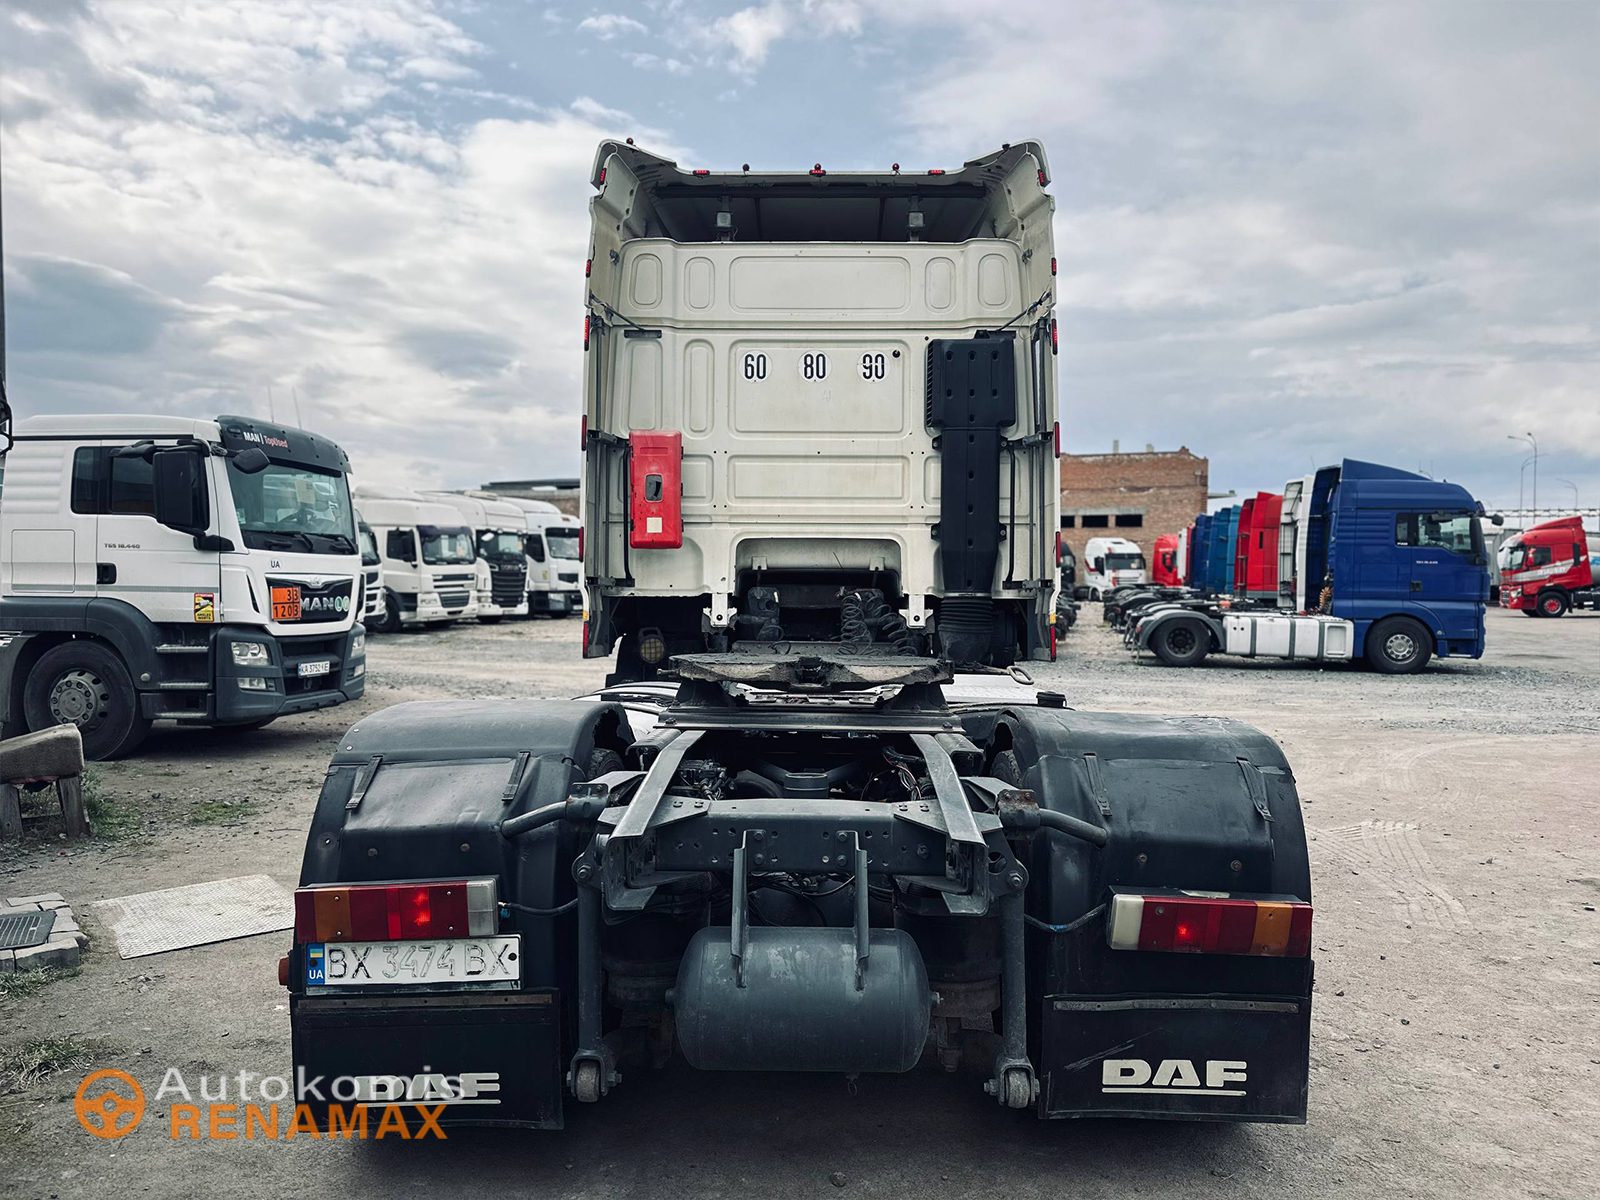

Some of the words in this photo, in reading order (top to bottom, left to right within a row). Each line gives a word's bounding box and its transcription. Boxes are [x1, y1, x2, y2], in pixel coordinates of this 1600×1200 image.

[744, 353, 767, 380] 60
[803, 353, 826, 380] 80
[862, 353, 885, 380] 90
[243, 431, 261, 443] MAN
[270, 560, 281, 569] UA
[286, 589, 299, 602] 33
[273, 603, 299, 618] 1203
[300, 597, 334, 612] MAN
[327, 946, 373, 980] BX
[381, 944, 456, 978] 3474
[464, 943, 510, 976] BX
[308, 969, 324, 980] UA
[1101, 1058, 1248, 1088] DAF
